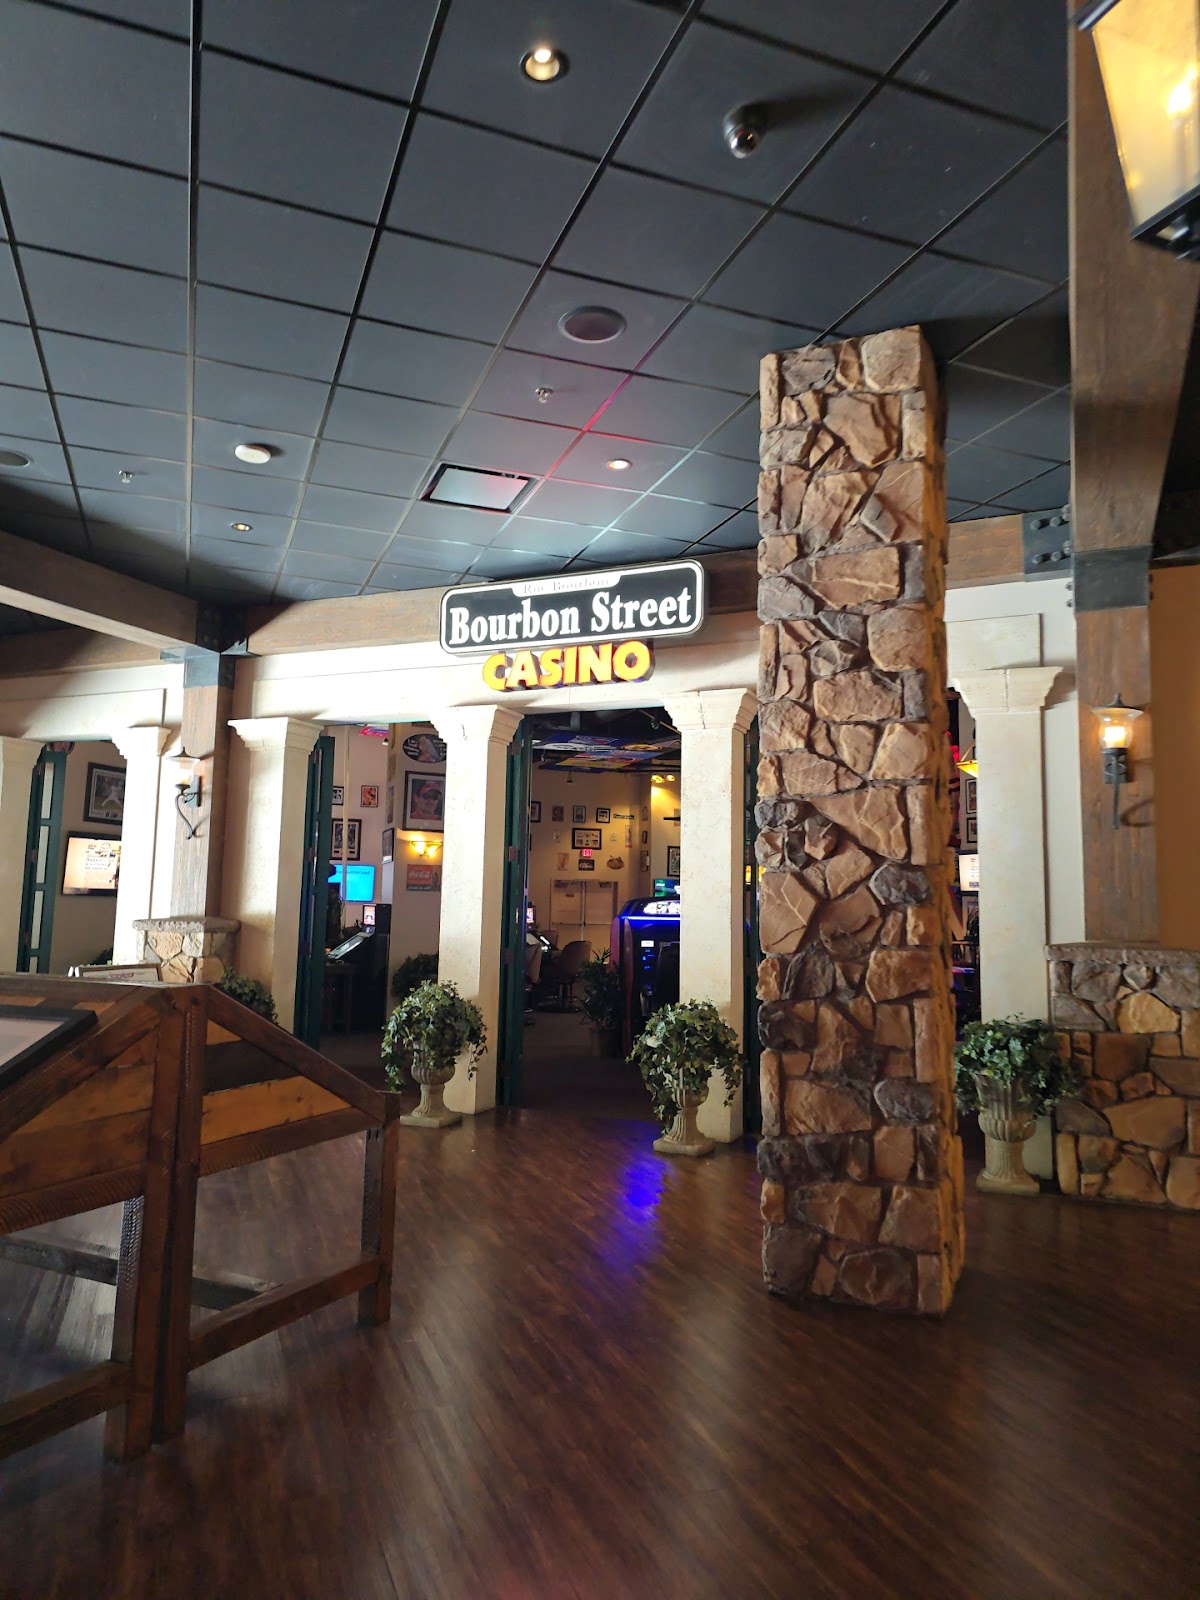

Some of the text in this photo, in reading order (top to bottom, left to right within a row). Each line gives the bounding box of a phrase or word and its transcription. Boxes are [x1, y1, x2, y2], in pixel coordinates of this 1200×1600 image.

[553, 577, 609, 591] Bourbon
[448, 586, 692, 645] Bourbon Street
[482, 640, 652, 691] CASINO
